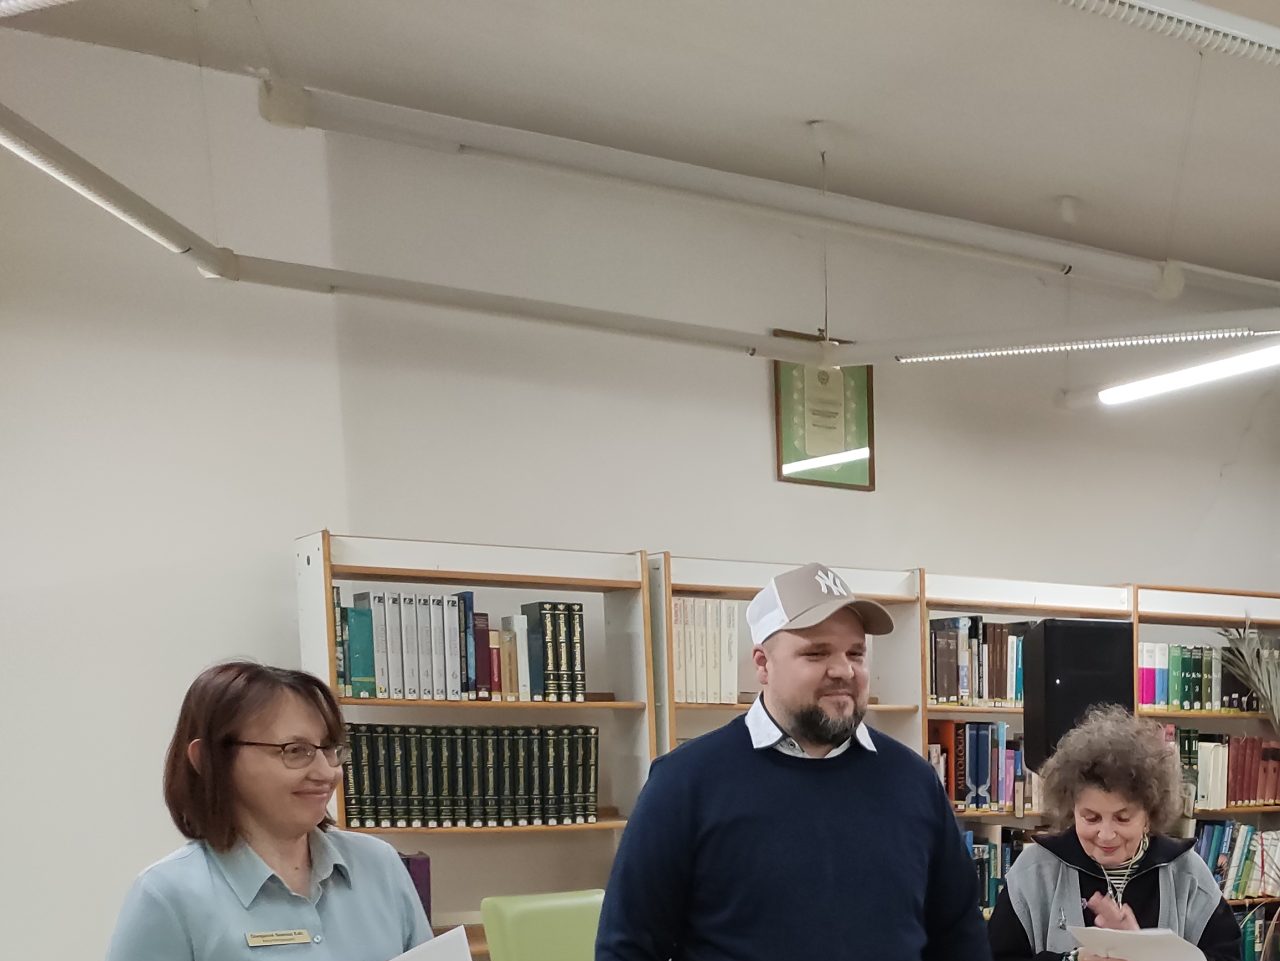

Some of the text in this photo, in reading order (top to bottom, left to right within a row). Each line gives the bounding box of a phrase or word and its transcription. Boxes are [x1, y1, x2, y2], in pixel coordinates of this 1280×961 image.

[544, 614, 553, 670] Britannica Hungarica
[558, 614, 566, 642] Hungarica
